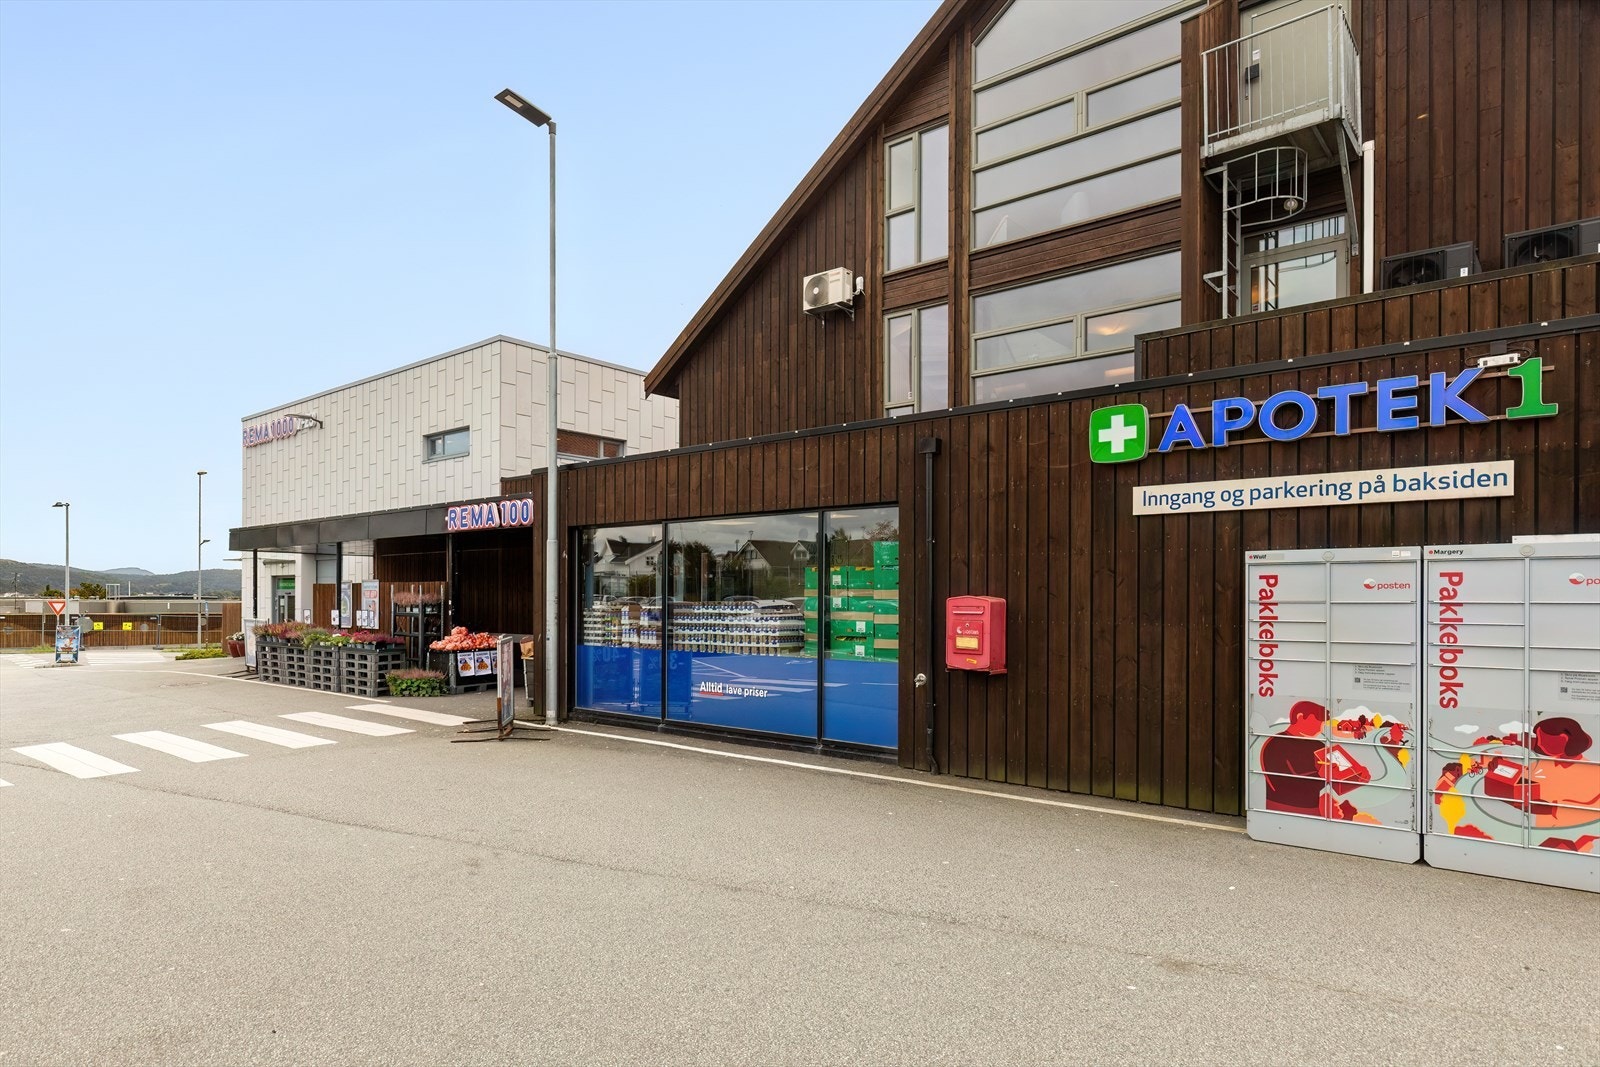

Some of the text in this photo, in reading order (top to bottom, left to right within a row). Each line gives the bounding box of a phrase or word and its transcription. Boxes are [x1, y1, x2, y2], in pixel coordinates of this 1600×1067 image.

[1157, 357, 1558, 453] APOTEK 1
[242, 415, 295, 447] REMA 1000
[1143, 468, 1508, 510] Inngang og parkering på baksiden
[447, 503, 500, 531] REMA
[1377, 582, 1411, 590] posten
[1259, 575, 1279, 697] Pakkeboks
[1439, 572, 1464, 708] Pakkeboks
[700, 681, 768, 698] Alltid lave priser
